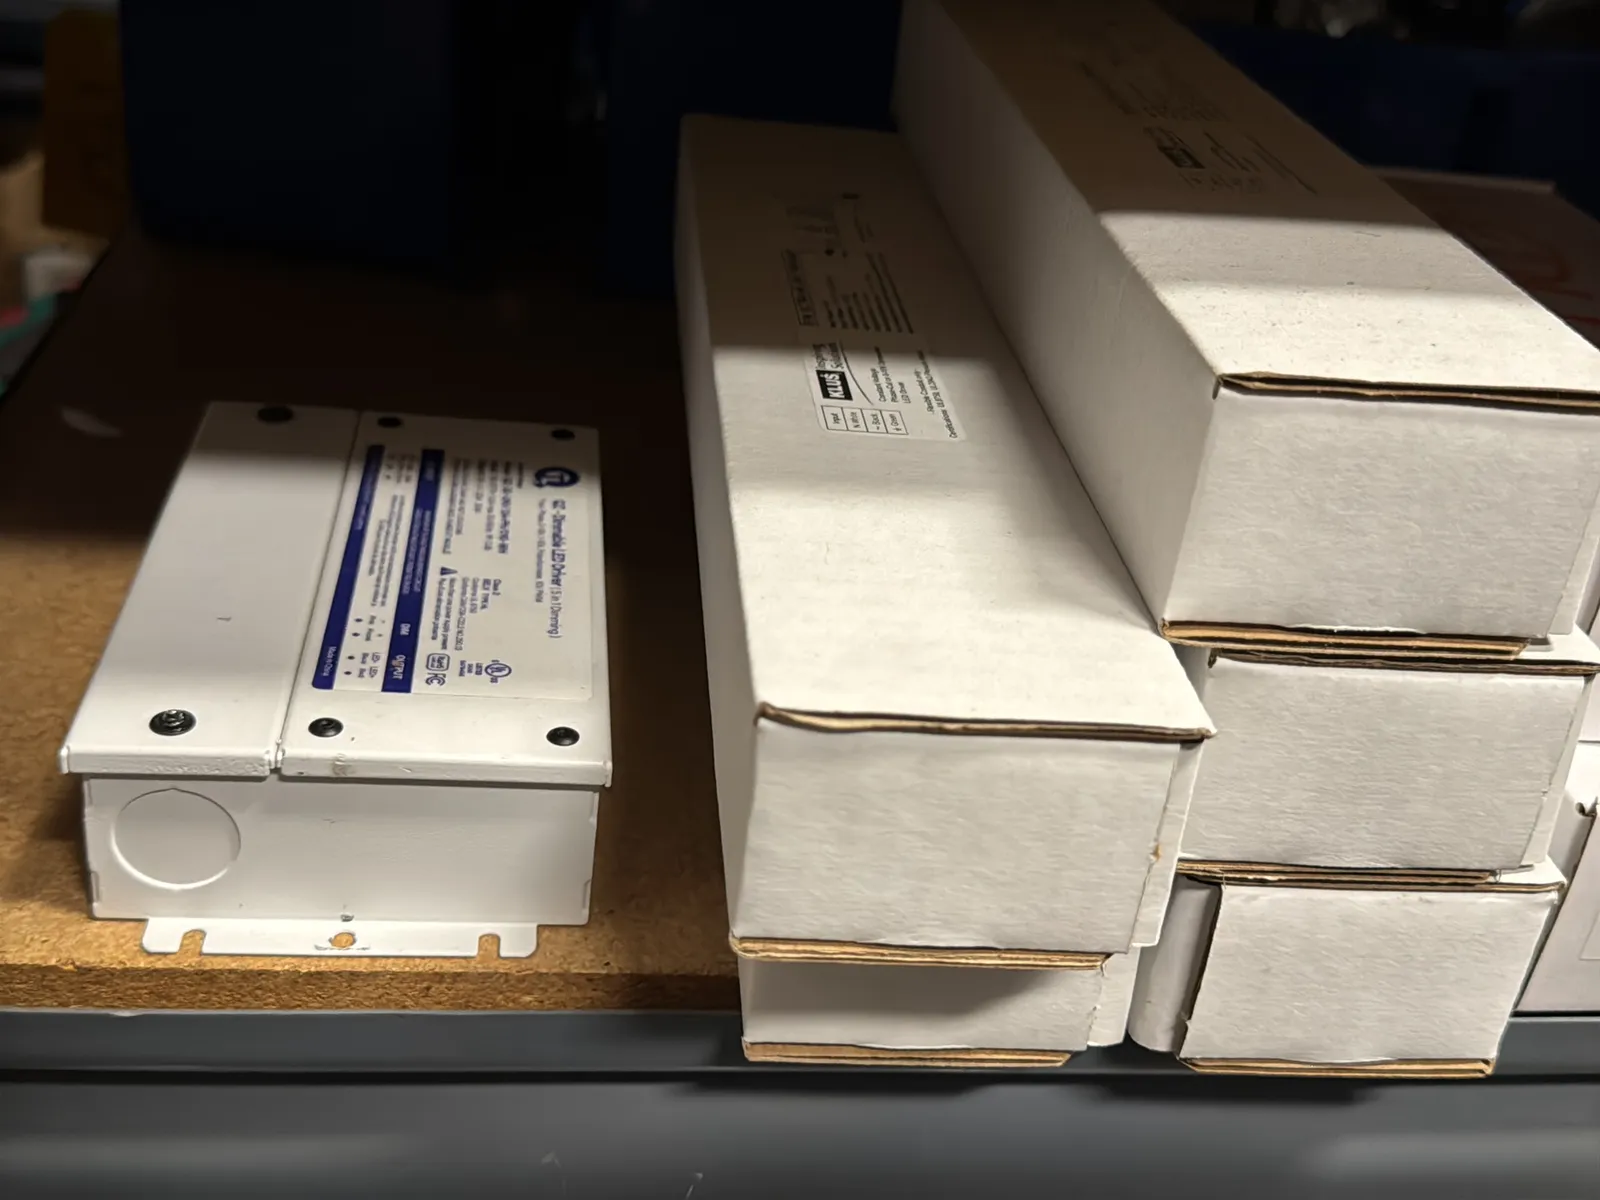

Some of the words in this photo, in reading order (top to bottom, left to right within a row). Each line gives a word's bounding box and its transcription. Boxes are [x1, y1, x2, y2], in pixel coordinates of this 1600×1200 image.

[830, 412, 841, 424] Input
[552, 514, 566, 548] Dimmable
[551, 549, 565, 562] LED
[551, 564, 565, 587] Driver
[546, 606, 562, 634] Dimming
